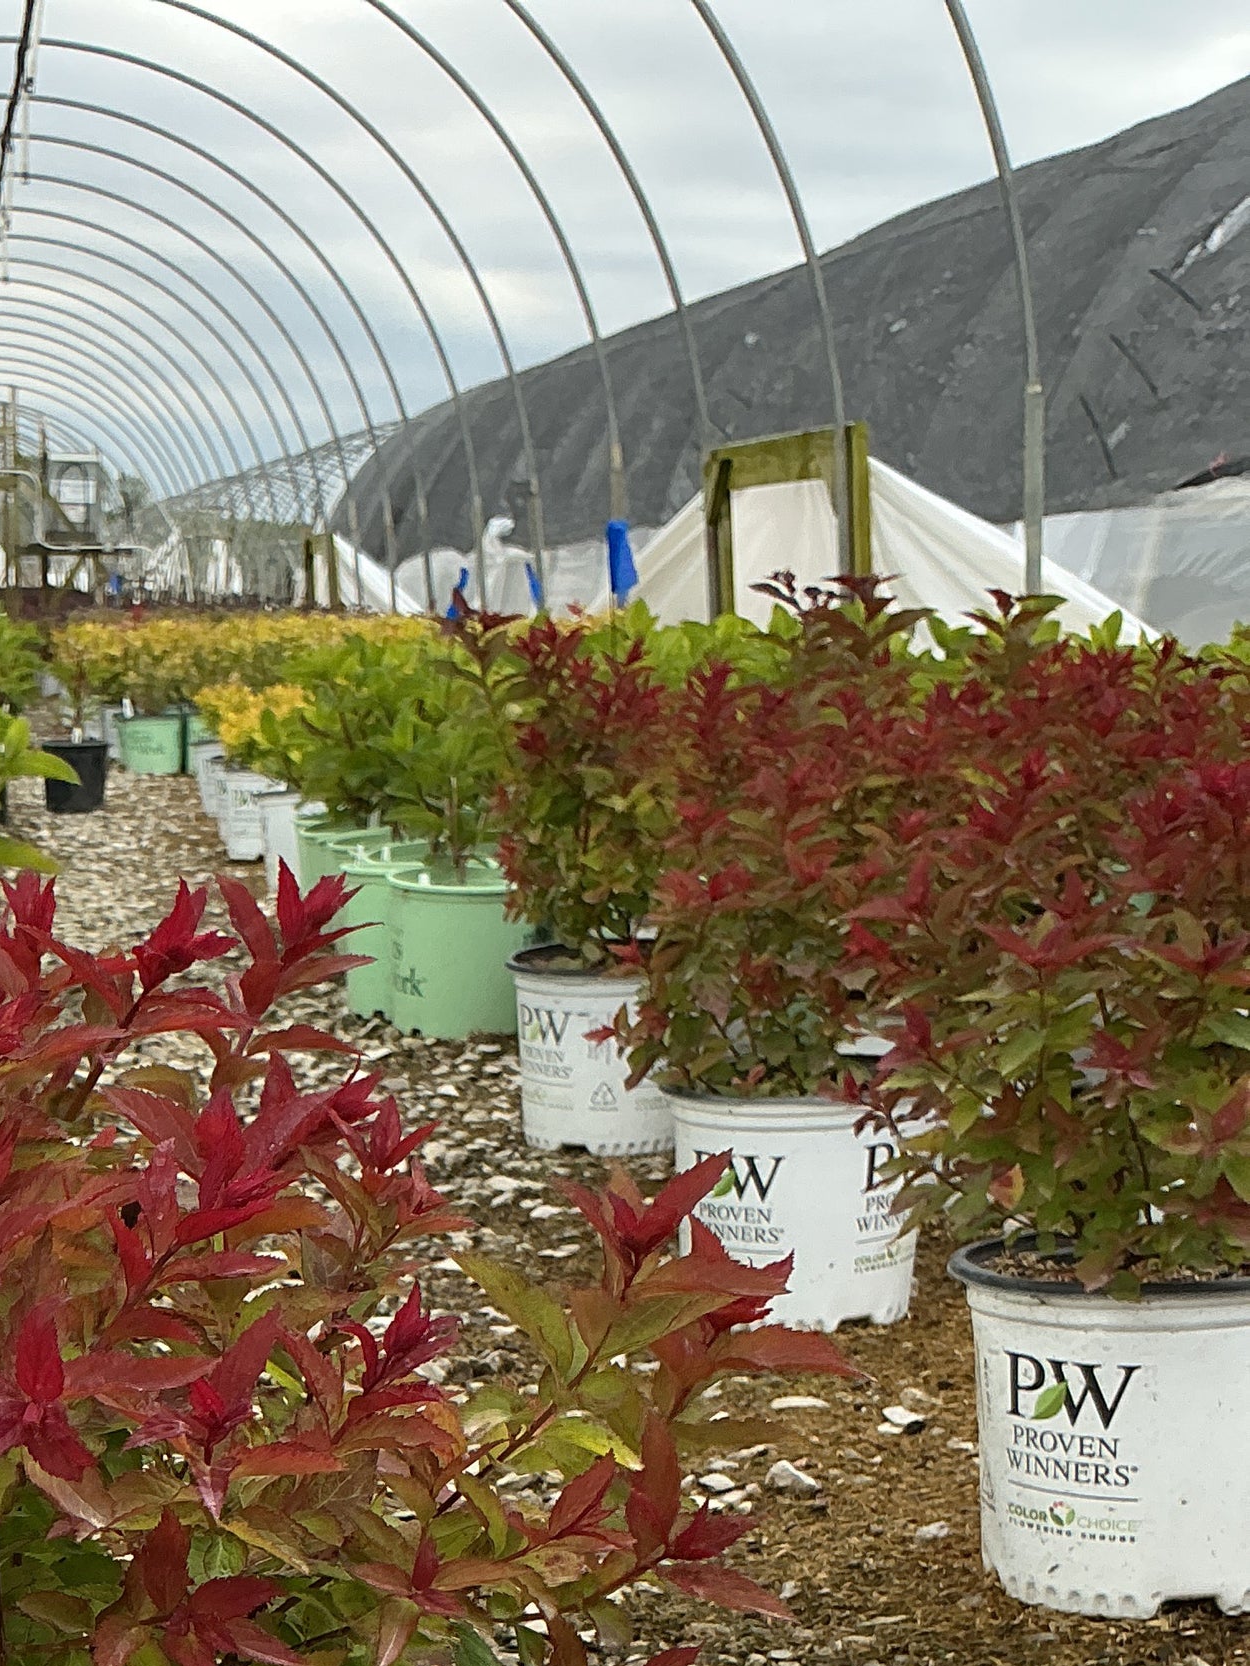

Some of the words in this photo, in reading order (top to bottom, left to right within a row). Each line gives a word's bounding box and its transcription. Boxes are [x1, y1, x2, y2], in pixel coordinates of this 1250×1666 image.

[693, 1149, 785, 1204] W
[699, 1201, 772, 1225] PROVEN
[865, 1191, 896, 1213] PRO
[707, 1222, 784, 1245] NNERS
[1002, 1350, 1142, 1431] PW
[1013, 1424, 1120, 1460] PROVEN
[1007, 1502, 1048, 1523] COLOR
